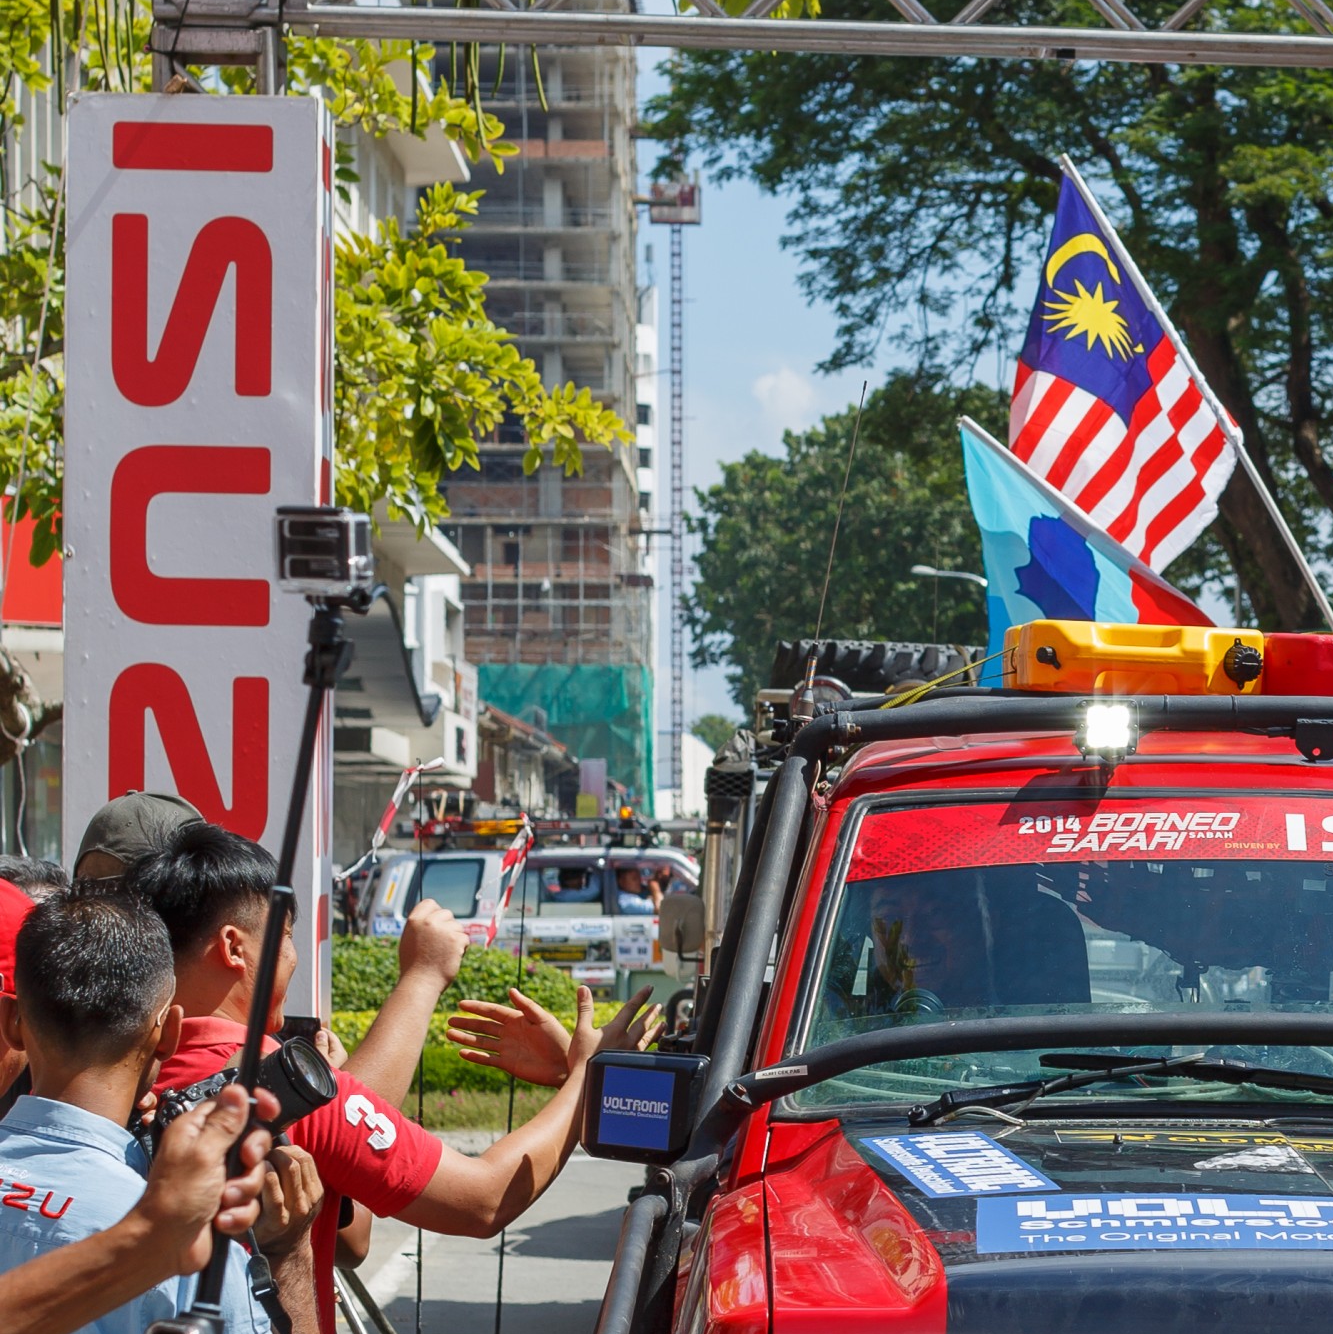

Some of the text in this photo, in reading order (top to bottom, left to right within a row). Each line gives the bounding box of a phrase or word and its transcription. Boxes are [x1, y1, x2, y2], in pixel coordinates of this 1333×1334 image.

[109, 120, 275, 845] ISUZ
[1018, 812, 1241, 835] 2014 BORNEO
[1046, 831, 1188, 853] SAFARI
[1188, 831, 1233, 839] SABAH
[1224, 841, 1281, 850] DRIVEN BY
[603, 1095, 670, 1115] VOLTRONIC
[343, 1093, 398, 1151] 3
[1019, 1233, 1087, 1244] The
[1099, 1230, 1241, 1244] Original
